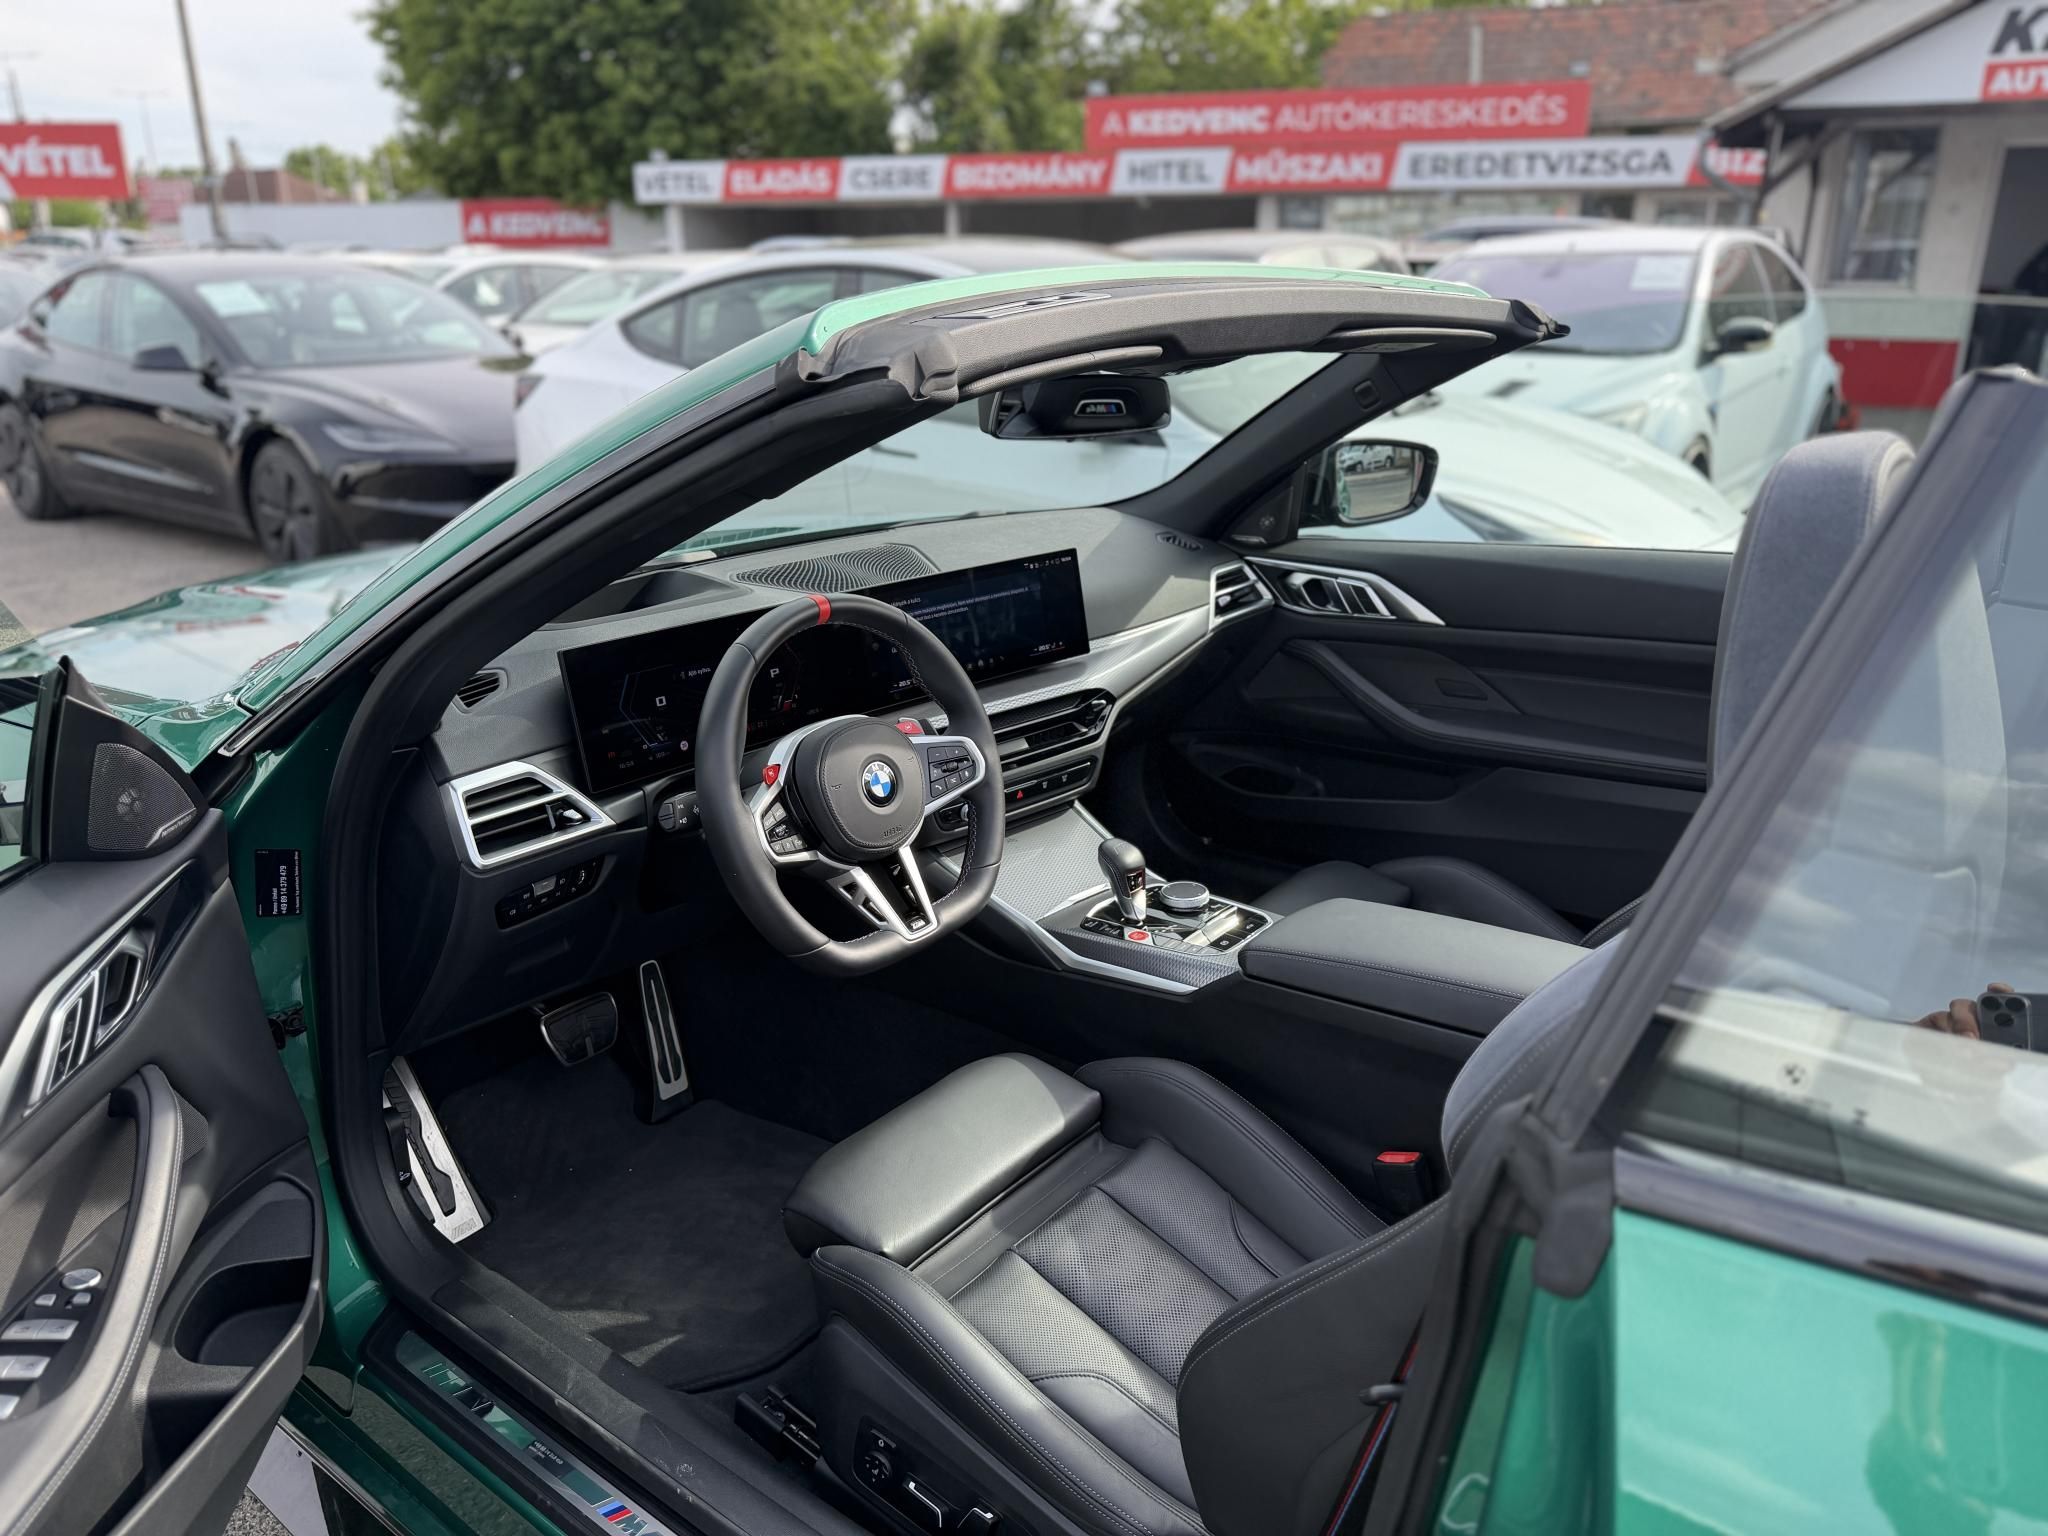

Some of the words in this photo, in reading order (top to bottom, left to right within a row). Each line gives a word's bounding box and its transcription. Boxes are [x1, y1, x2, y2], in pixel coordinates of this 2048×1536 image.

[1991, 7, 2048, 54] K
[1103, 113, 1124, 136] A
[1129, 106, 1269, 136] KEDVENC
[1275, 93, 1567, 132] AUTÓKERESKEDÉS
[731, 161, 831, 193] ELADÁS
[849, 163, 931, 191] CSERE
[953, 153, 1106, 190] BIZOMÁNY
[1128, 156, 1210, 185] HITEL
[1235, 148, 1383, 183] MŰSZAKI
[1410, 145, 1673, 179] EREDETVIZSGA
[641, 167, 711, 194] VÉTEL
[468, 212, 486, 237] A
[770, 667, 780, 678] P
